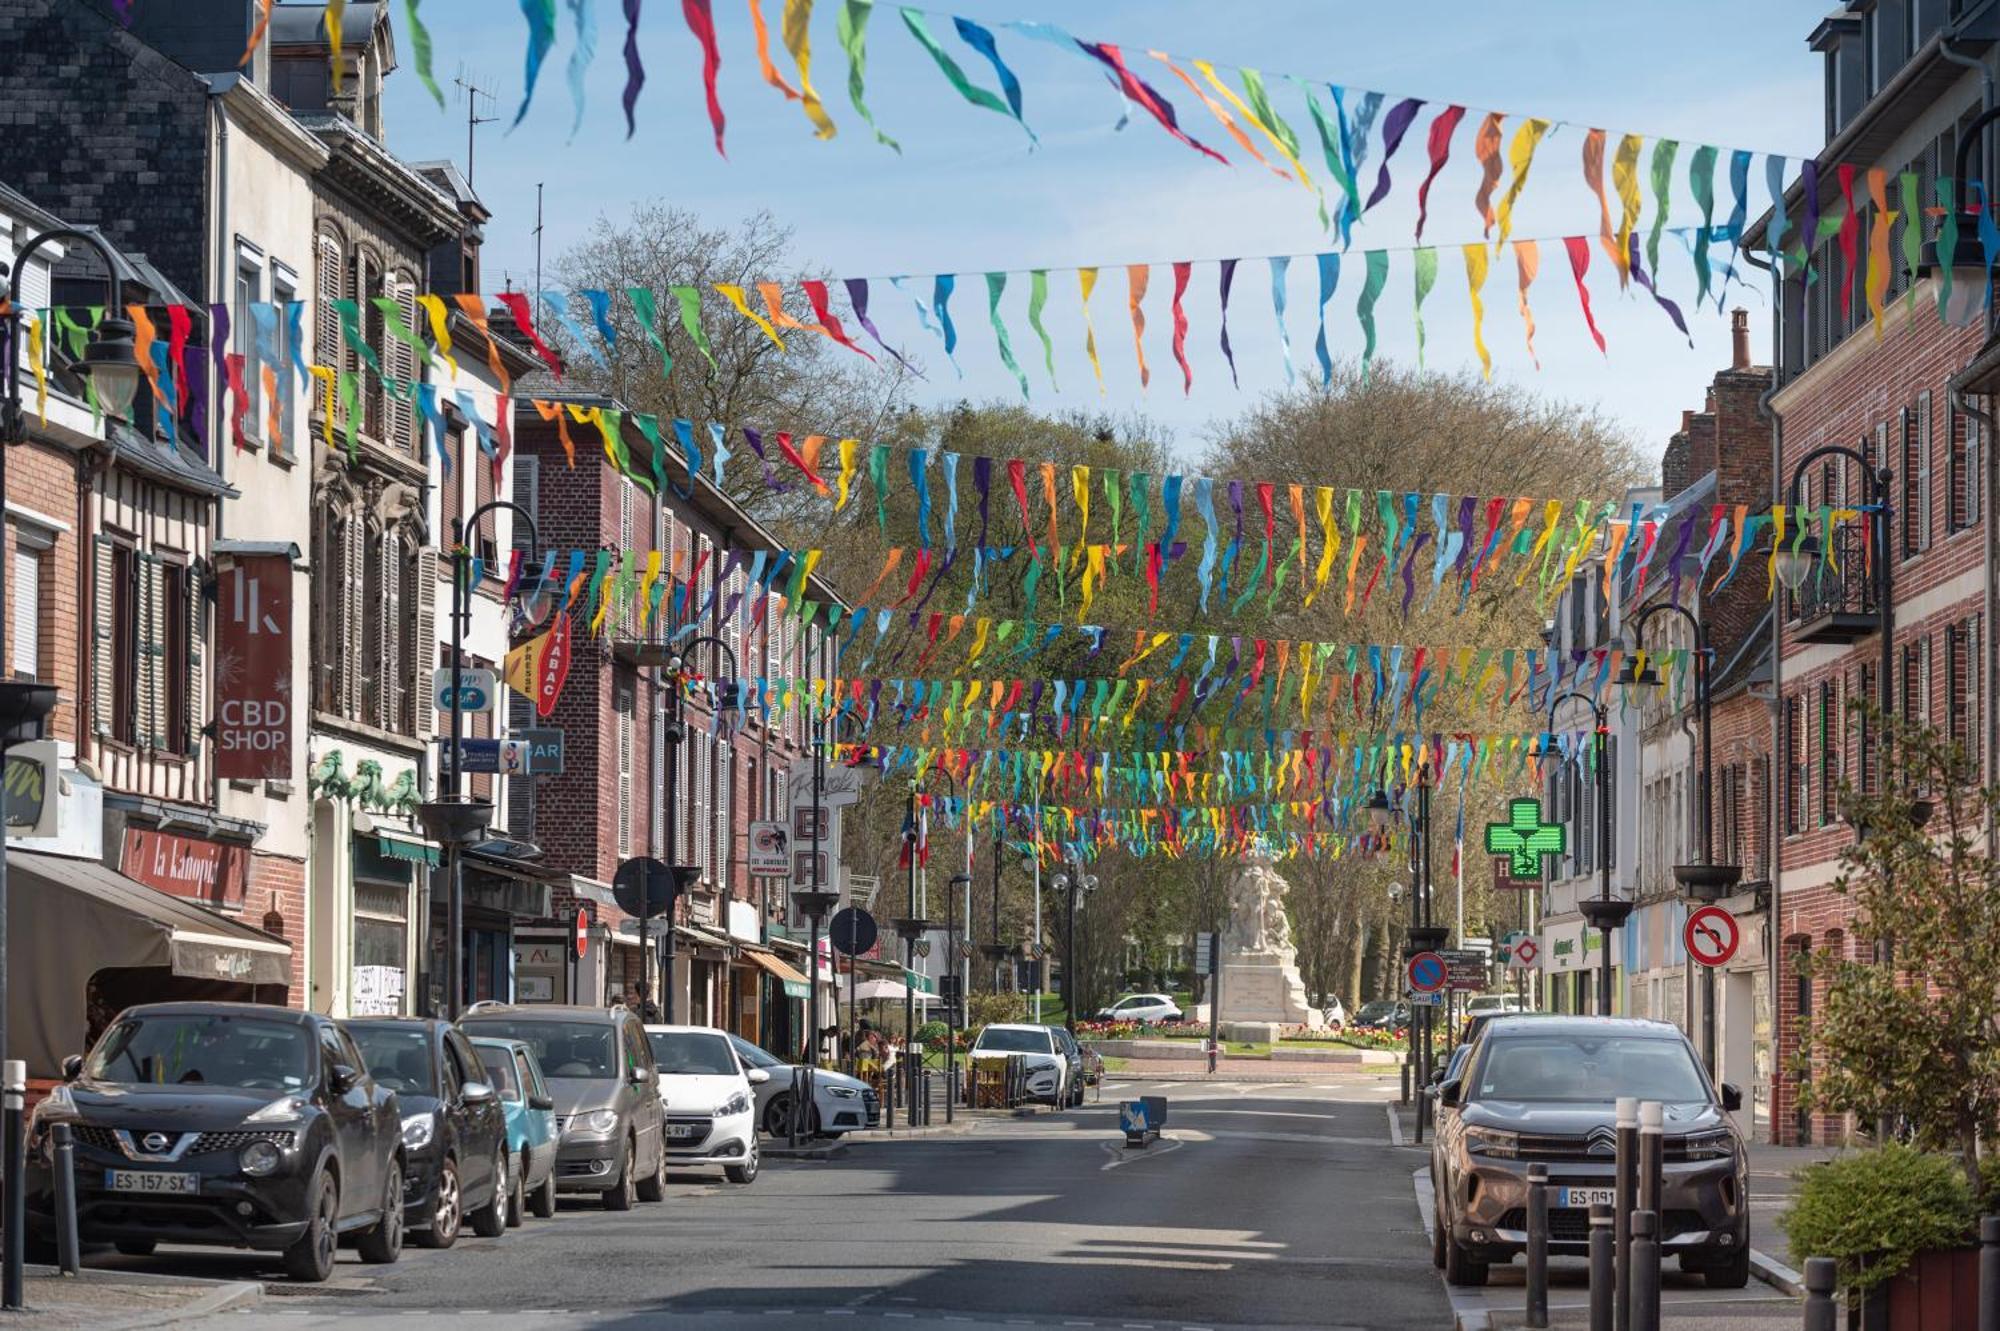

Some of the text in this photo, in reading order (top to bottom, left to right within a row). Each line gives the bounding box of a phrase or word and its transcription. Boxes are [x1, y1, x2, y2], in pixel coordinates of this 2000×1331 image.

[543, 632, 565, 696] TABAC
[221, 700, 286, 727] CBD
[222, 730, 286, 750] SHOP
[153, 836, 166, 877] la
[116, 1174, 186, 1191] ES-157-SX
[1570, 1191, 1614, 1205] GS-091
